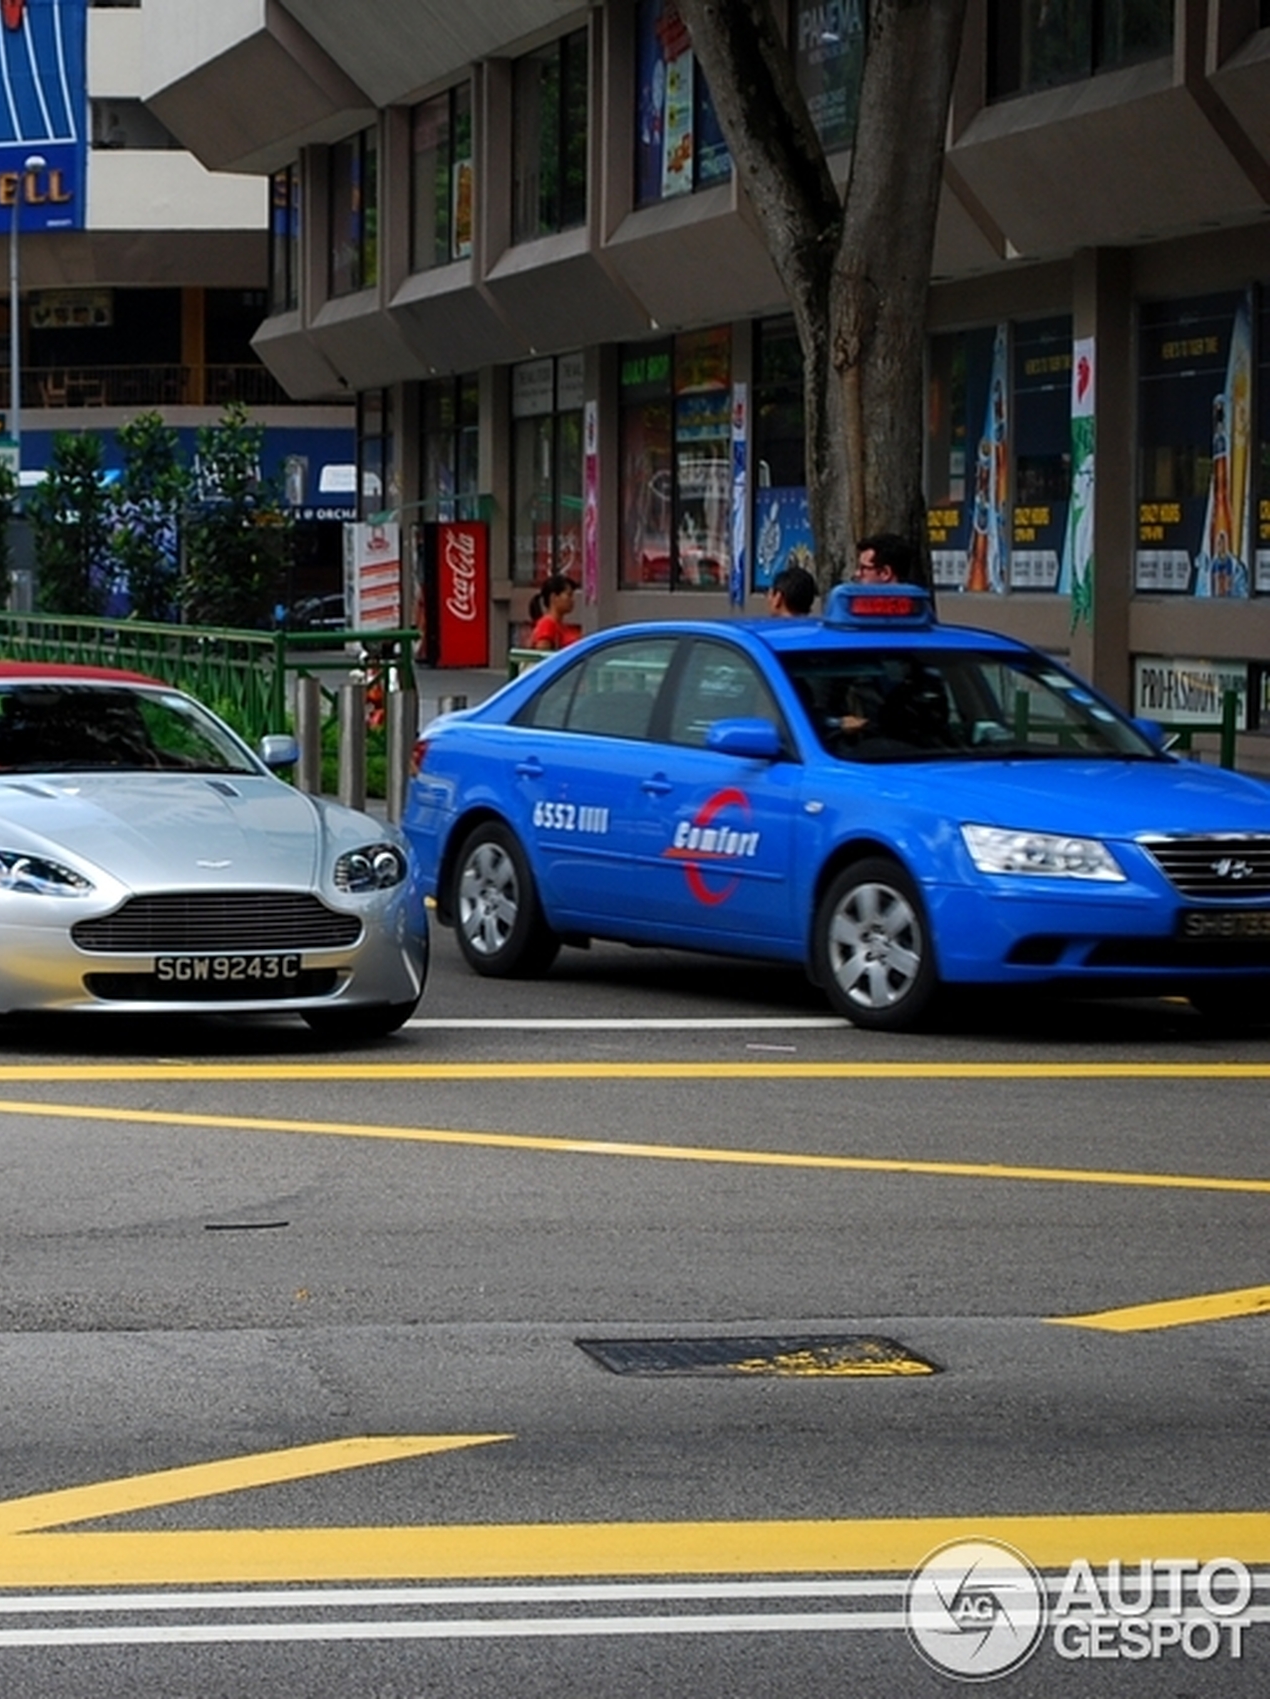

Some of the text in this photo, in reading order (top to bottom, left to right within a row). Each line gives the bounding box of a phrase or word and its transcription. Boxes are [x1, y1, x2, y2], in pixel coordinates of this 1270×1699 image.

[446, 528, 477, 621] Coca-Cola
[533, 801, 576, 831] 6552
[673, 821, 760, 857] Comfort
